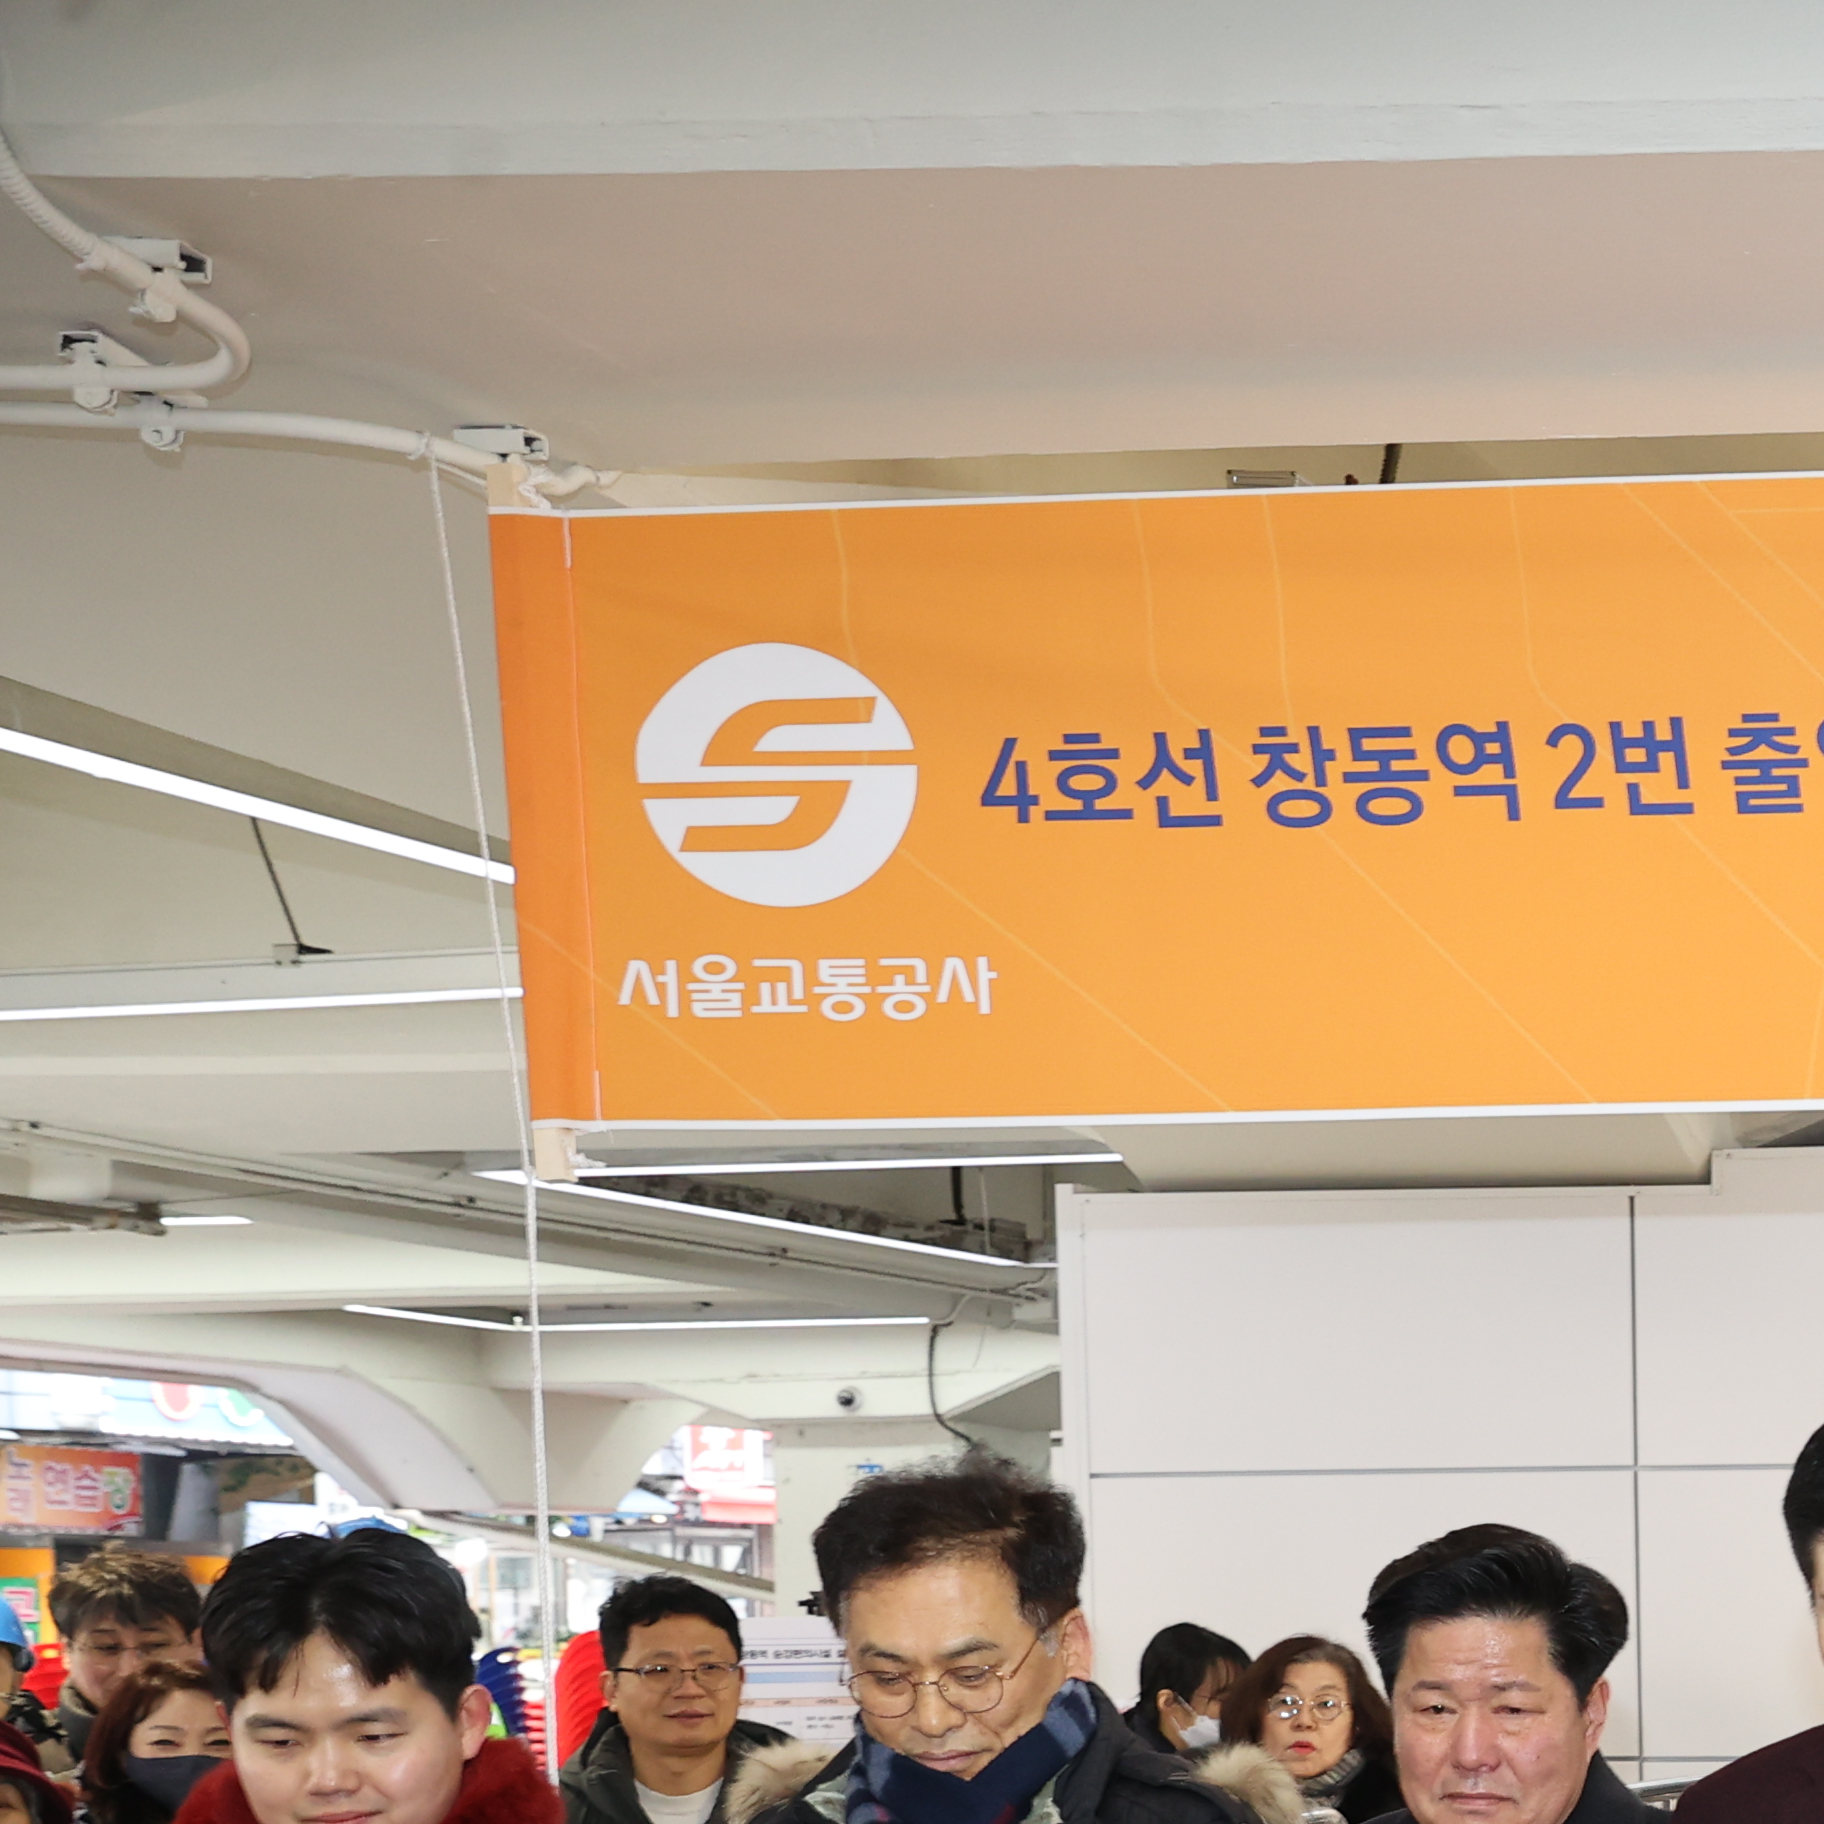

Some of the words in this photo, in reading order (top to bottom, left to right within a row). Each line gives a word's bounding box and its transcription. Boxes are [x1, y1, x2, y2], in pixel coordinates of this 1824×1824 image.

[981, 728, 1222, 829] 4호선
[1252, 720, 1521, 829] 창동역
[1547, 715, 1695, 817] 2번
[618, 953, 999, 1023] 서울교통공사
